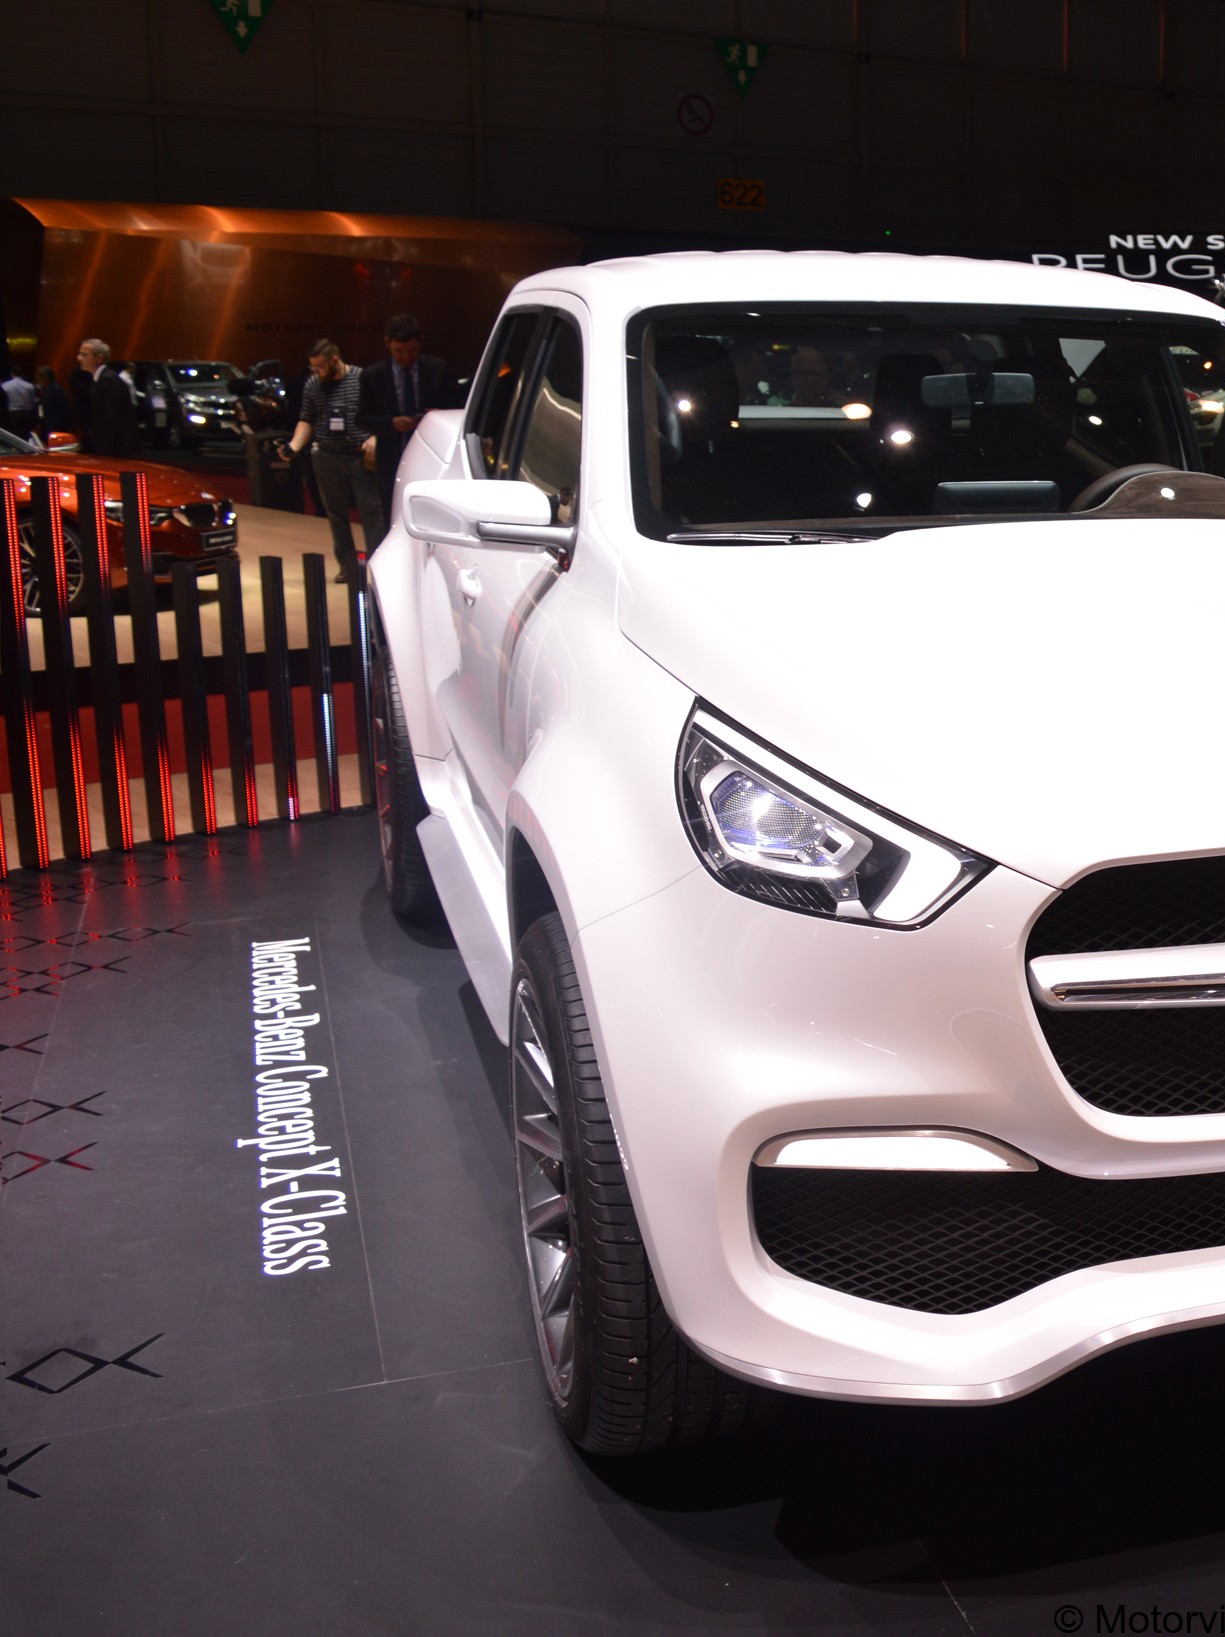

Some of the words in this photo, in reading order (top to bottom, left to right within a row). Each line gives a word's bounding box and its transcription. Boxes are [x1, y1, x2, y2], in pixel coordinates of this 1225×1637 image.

[720, 182, 762, 207] 622
[1108, 234, 1193, 250] NEW
[252, 936, 321, 1066] Mercedes-Benz
[236, 1064, 332, 1162] Concept
[260, 1157, 348, 1276] X-Class
